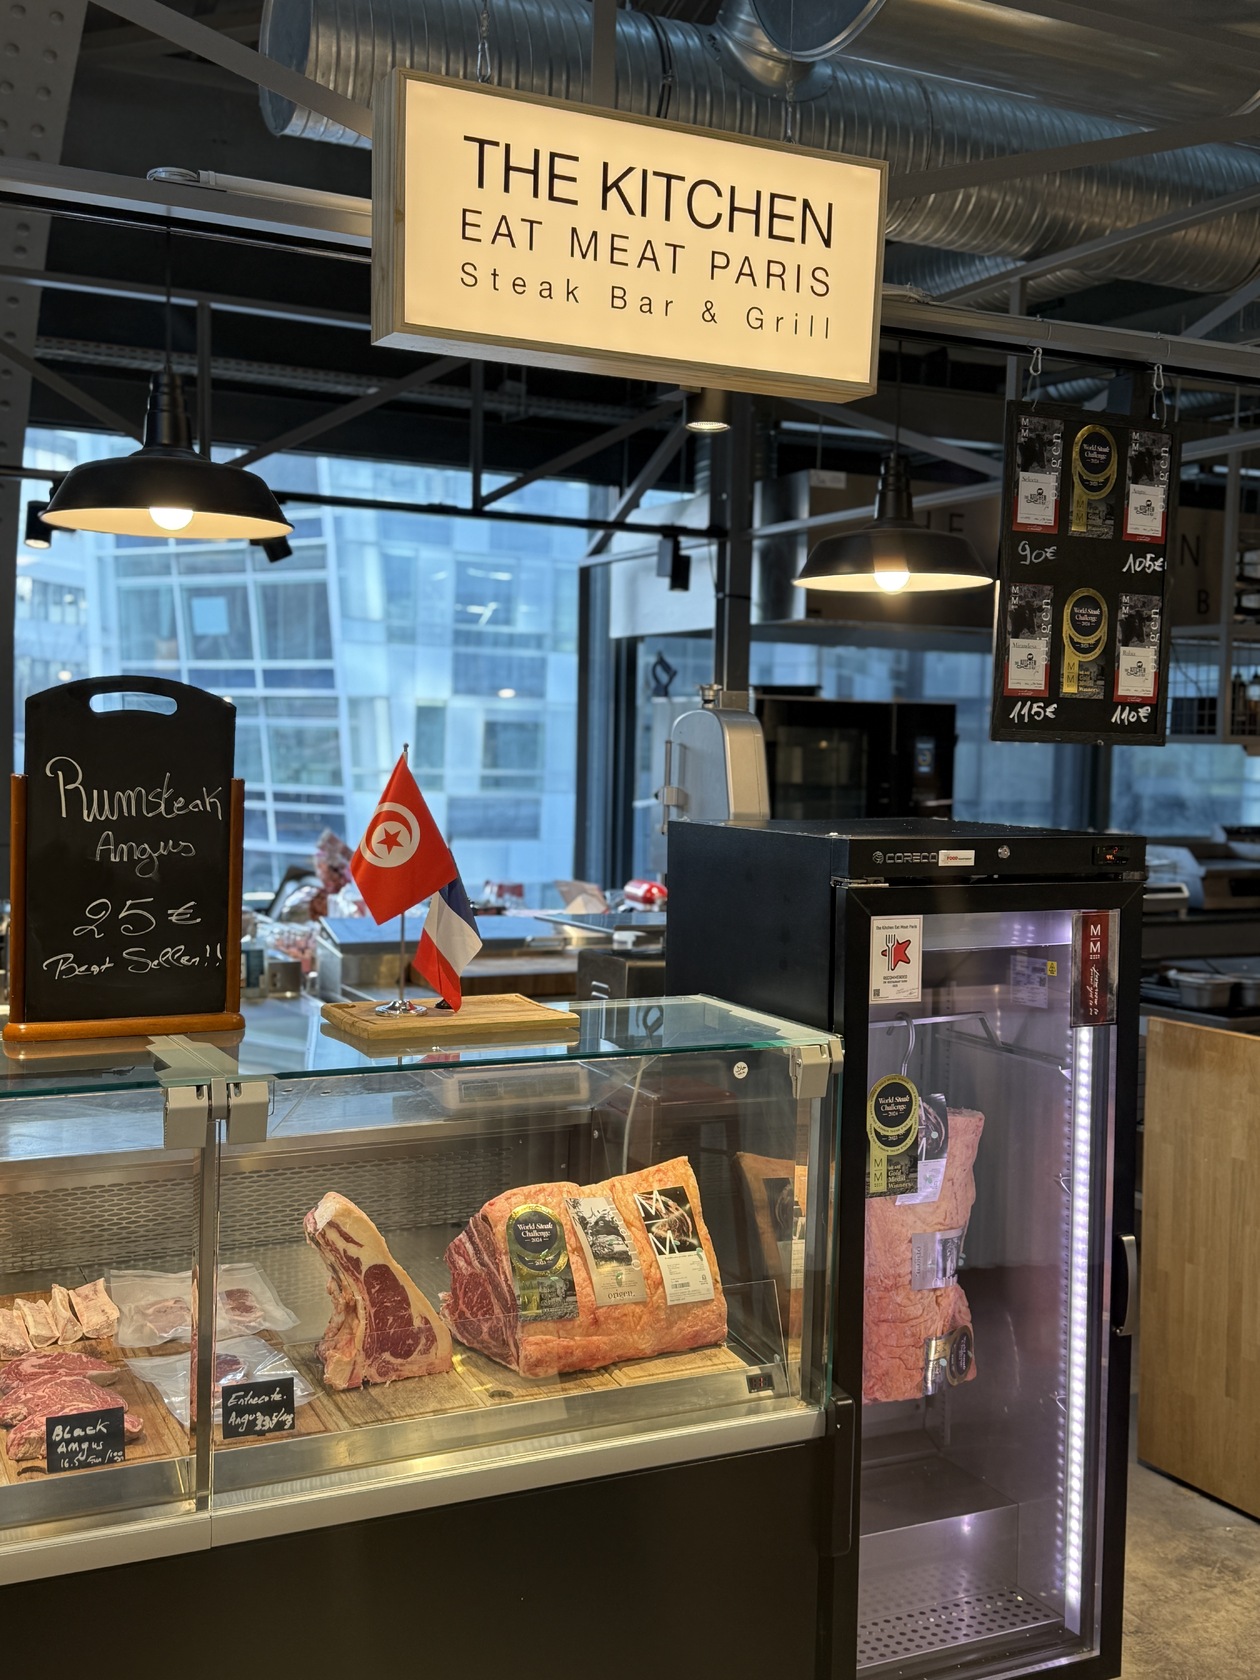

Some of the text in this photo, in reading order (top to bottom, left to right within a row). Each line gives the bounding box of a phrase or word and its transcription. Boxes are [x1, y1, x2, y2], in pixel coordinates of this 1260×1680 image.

[463, 134, 834, 249] THE KITCHEN
[461, 208, 831, 297] EAT MEAT PARIS
[460, 262, 830, 340] Steak Bar & Grill
[1018, 540, 1057, 565] 90€
[1009, 700, 1058, 723] 115€
[1111, 704, 1151, 725] 110€
[45, 756, 222, 822] Rumsteak
[94, 830, 197, 878] Angus
[885, 852, 938, 864] CORECO
[1090, 924, 1101, 936] M
[1089, 941, 1101, 953] M
[878, 1096, 894, 1104] World
[881, 1103, 907, 1112] Challenge
[874, 1159, 883, 1168] M
[873, 1173, 883, 1182] M
[517, 1223, 535, 1231] World
[521, 1229, 551, 1238] Challenge
